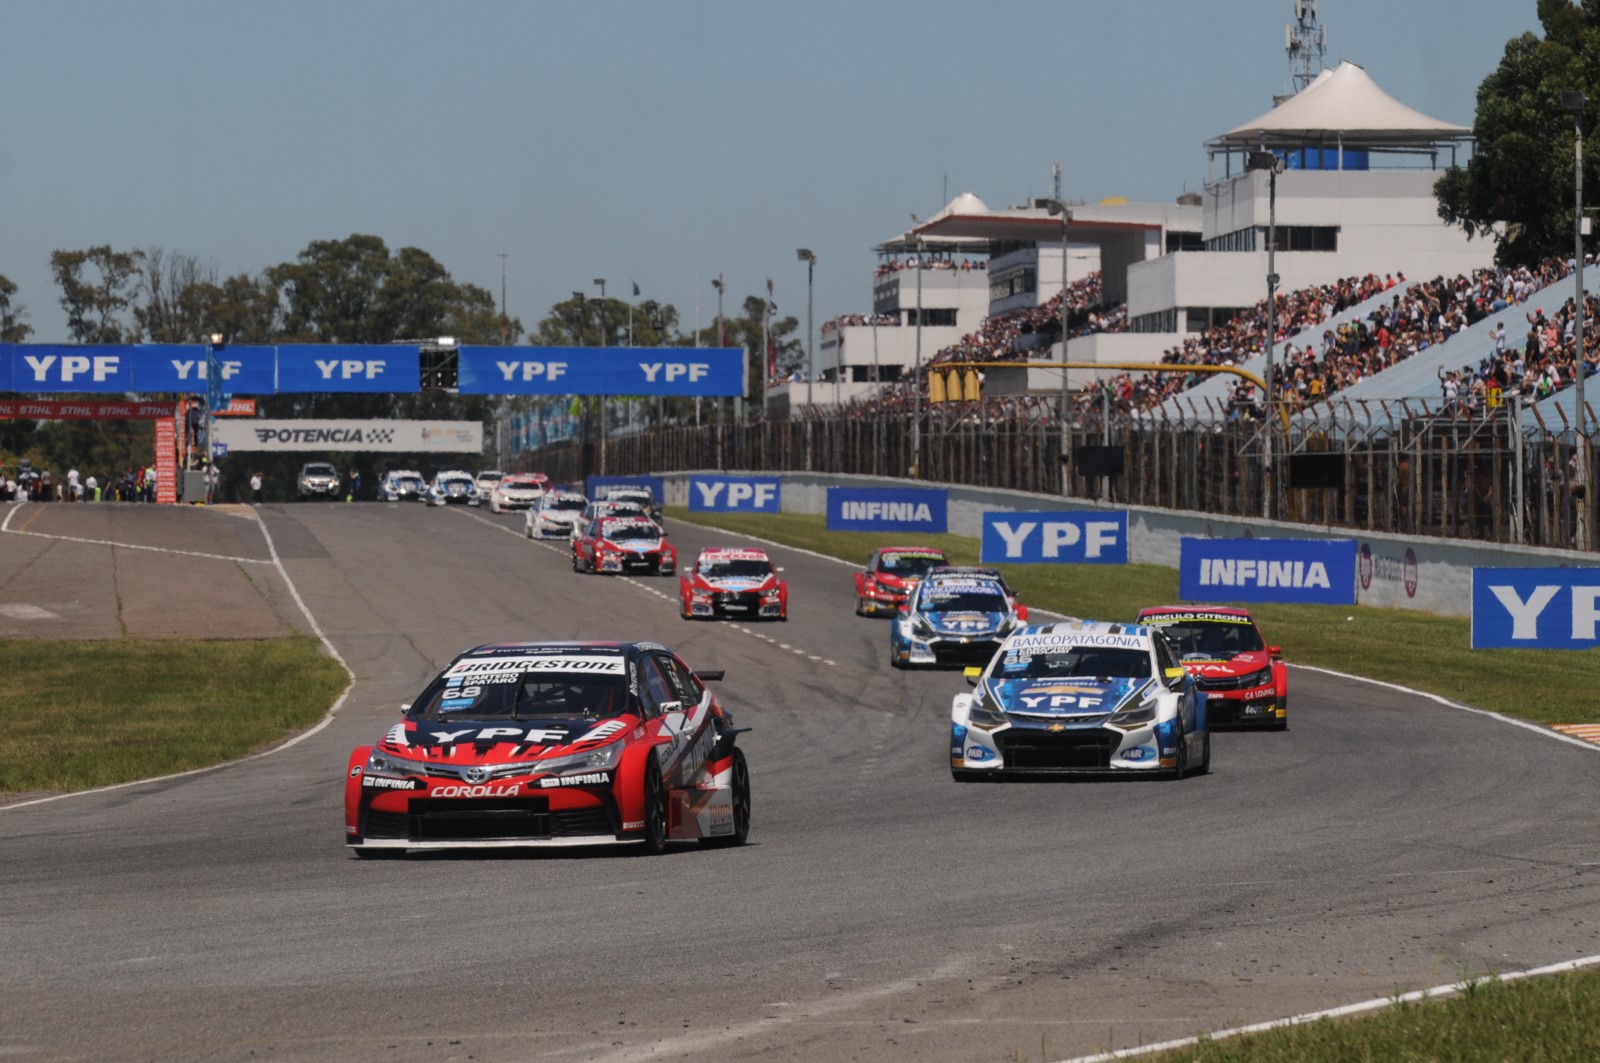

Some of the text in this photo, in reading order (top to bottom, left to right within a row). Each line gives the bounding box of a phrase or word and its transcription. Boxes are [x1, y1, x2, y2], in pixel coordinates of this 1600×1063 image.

[25, 356, 119, 381] YPF
[316, 360, 385, 379] YPF
[497, 362, 568, 380] YPF
[640, 363, 710, 382] YPF
[19, 405, 49, 414] STIHL
[60, 406, 92, 415] STIHL
[98, 406, 130, 415] STIHL
[138, 406, 170, 415] STIHL
[255, 428, 363, 443] POTENCIA
[696, 482, 776, 507] YPF
[842, 501, 932, 522] INFINIA
[992, 522, 1119, 558] YPF
[1200, 559, 1330, 588] INFINIA
[942, 621, 990, 631] YPF
[1013, 634, 1141, 648] BANCOPATAGONIA
[453, 660, 622, 674] BRIDGESTONE
[463, 677, 518, 686] SPATARO
[465, 672, 519, 682] SANTERO
[442, 685, 481, 700] 68
[1020, 696, 1102, 708] YPF
[430, 727, 569, 743] YPF
[375, 777, 415, 790] INFINIA
[560, 772, 610, 786] INFINIA
[431, 785, 519, 798] COROLLA
